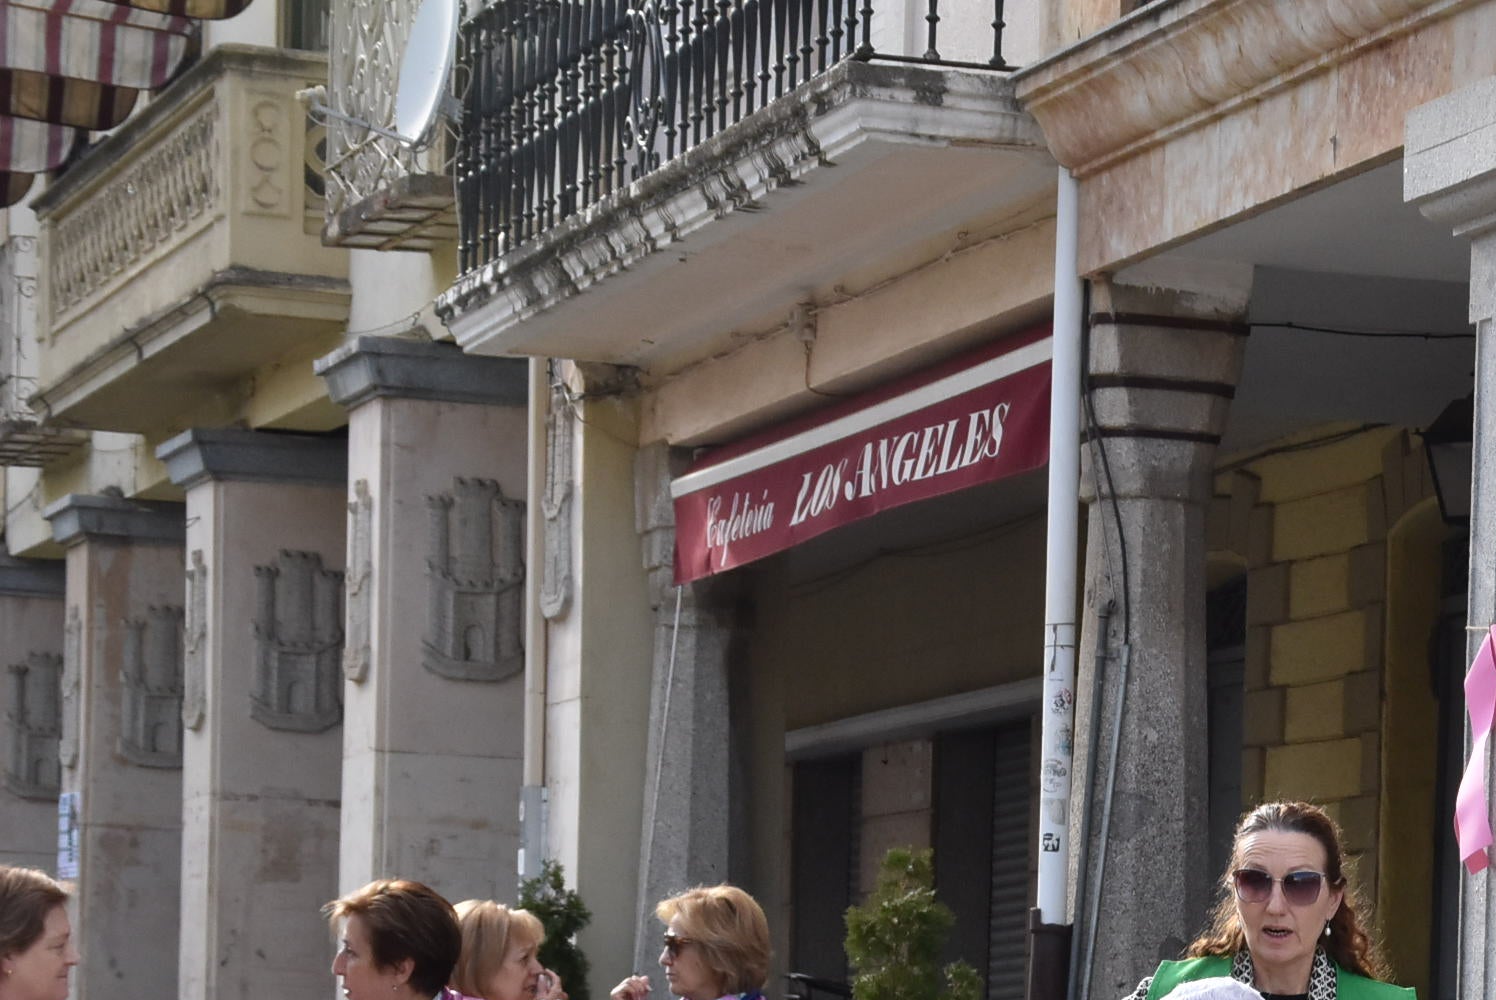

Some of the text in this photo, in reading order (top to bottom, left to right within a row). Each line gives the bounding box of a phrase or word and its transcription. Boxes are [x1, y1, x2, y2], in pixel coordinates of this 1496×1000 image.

[706, 401, 1012, 566] Cafetería LOS ANGELES
